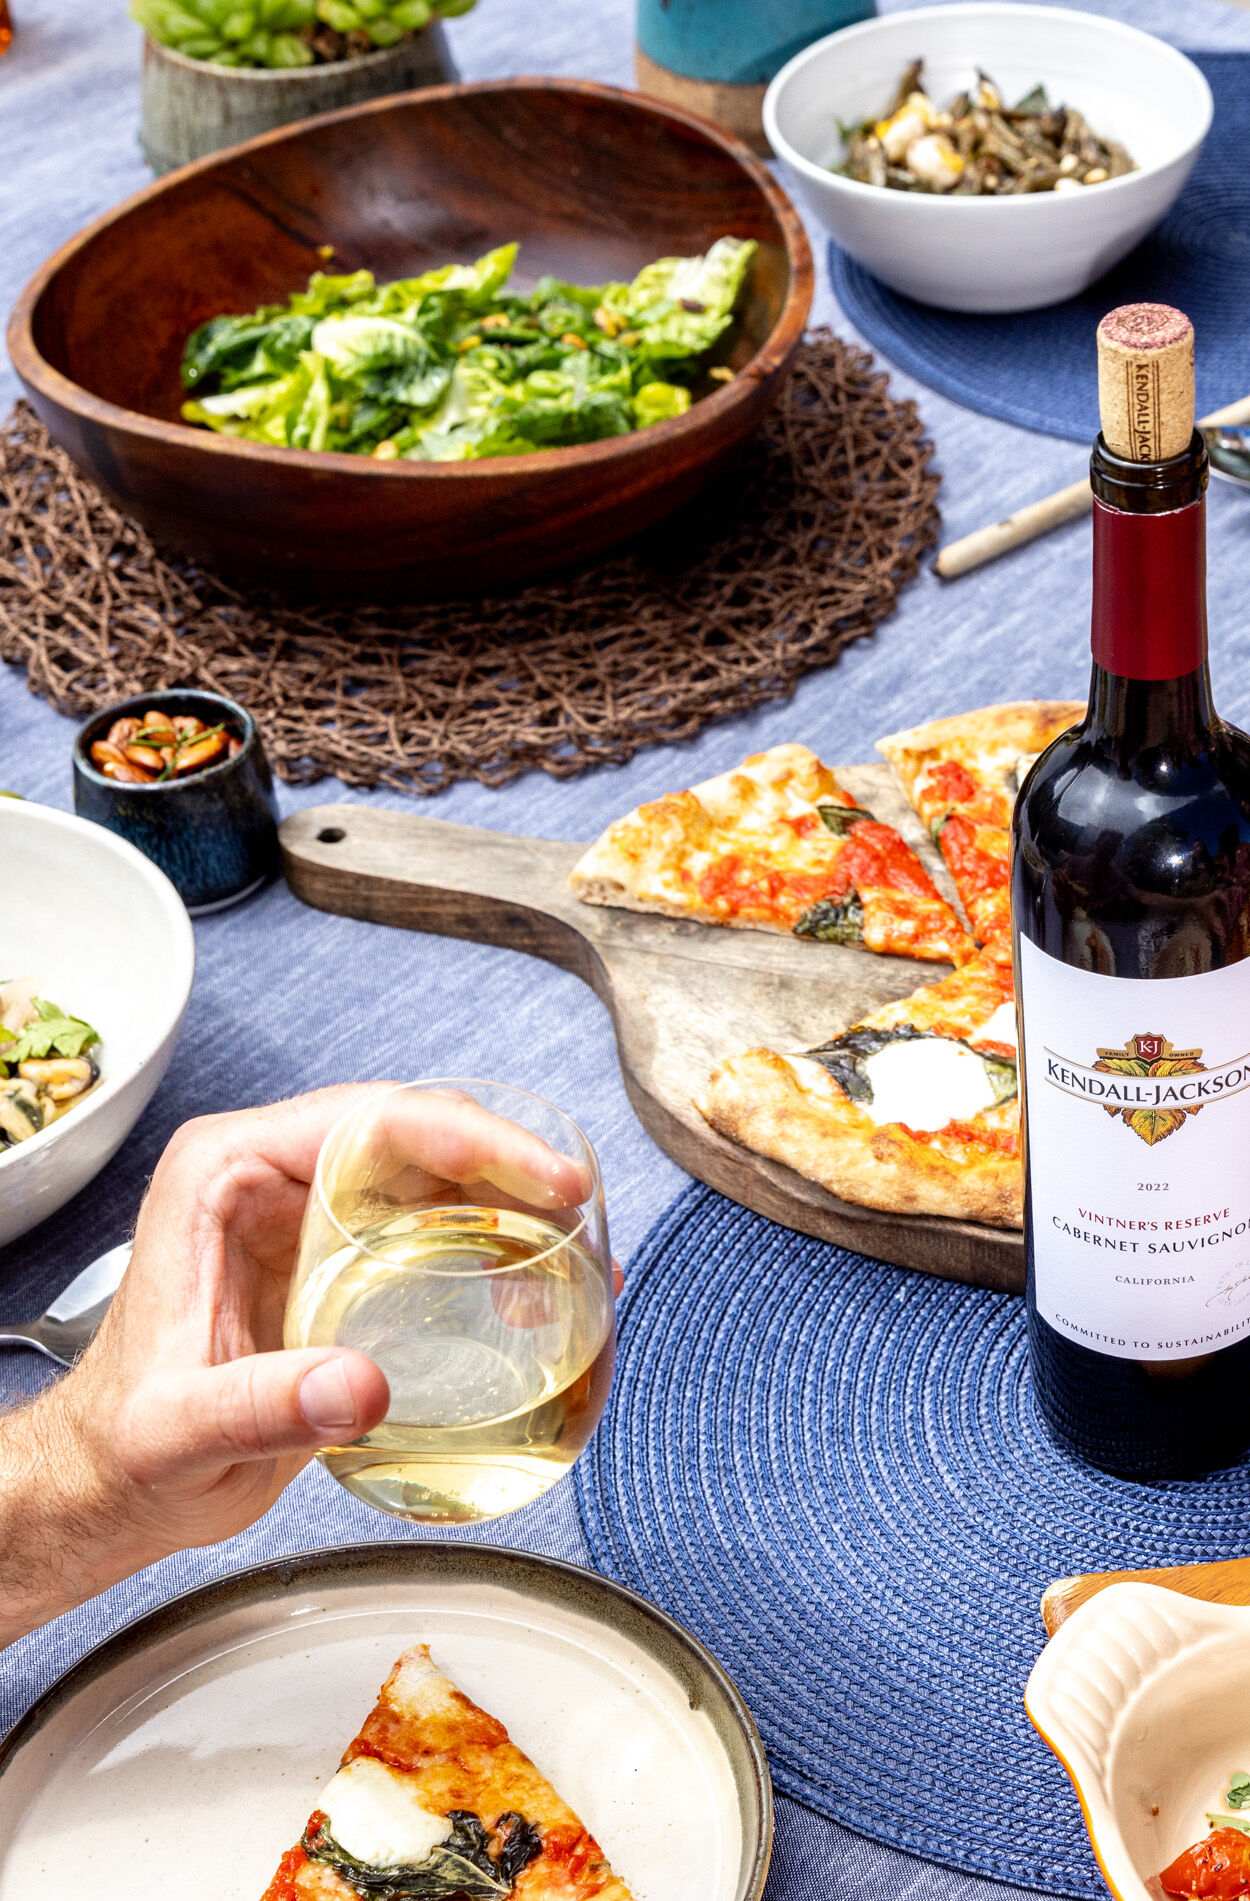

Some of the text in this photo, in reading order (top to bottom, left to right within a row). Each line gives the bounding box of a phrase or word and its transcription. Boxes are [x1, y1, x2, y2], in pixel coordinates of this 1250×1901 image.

[1139, 1040, 1159, 1055] K-J
[1136, 1182, 1170, 1193] 2022
[1078, 1207, 1230, 1232] VINTNER'S RESERVE
[1052, 1216, 1140, 1254] CABERNET
[1115, 1275, 1196, 1286] CALIFORNIA
[1055, 1313, 1126, 1347] COMMITTED
[1133, 1340, 1150, 1350] TO
